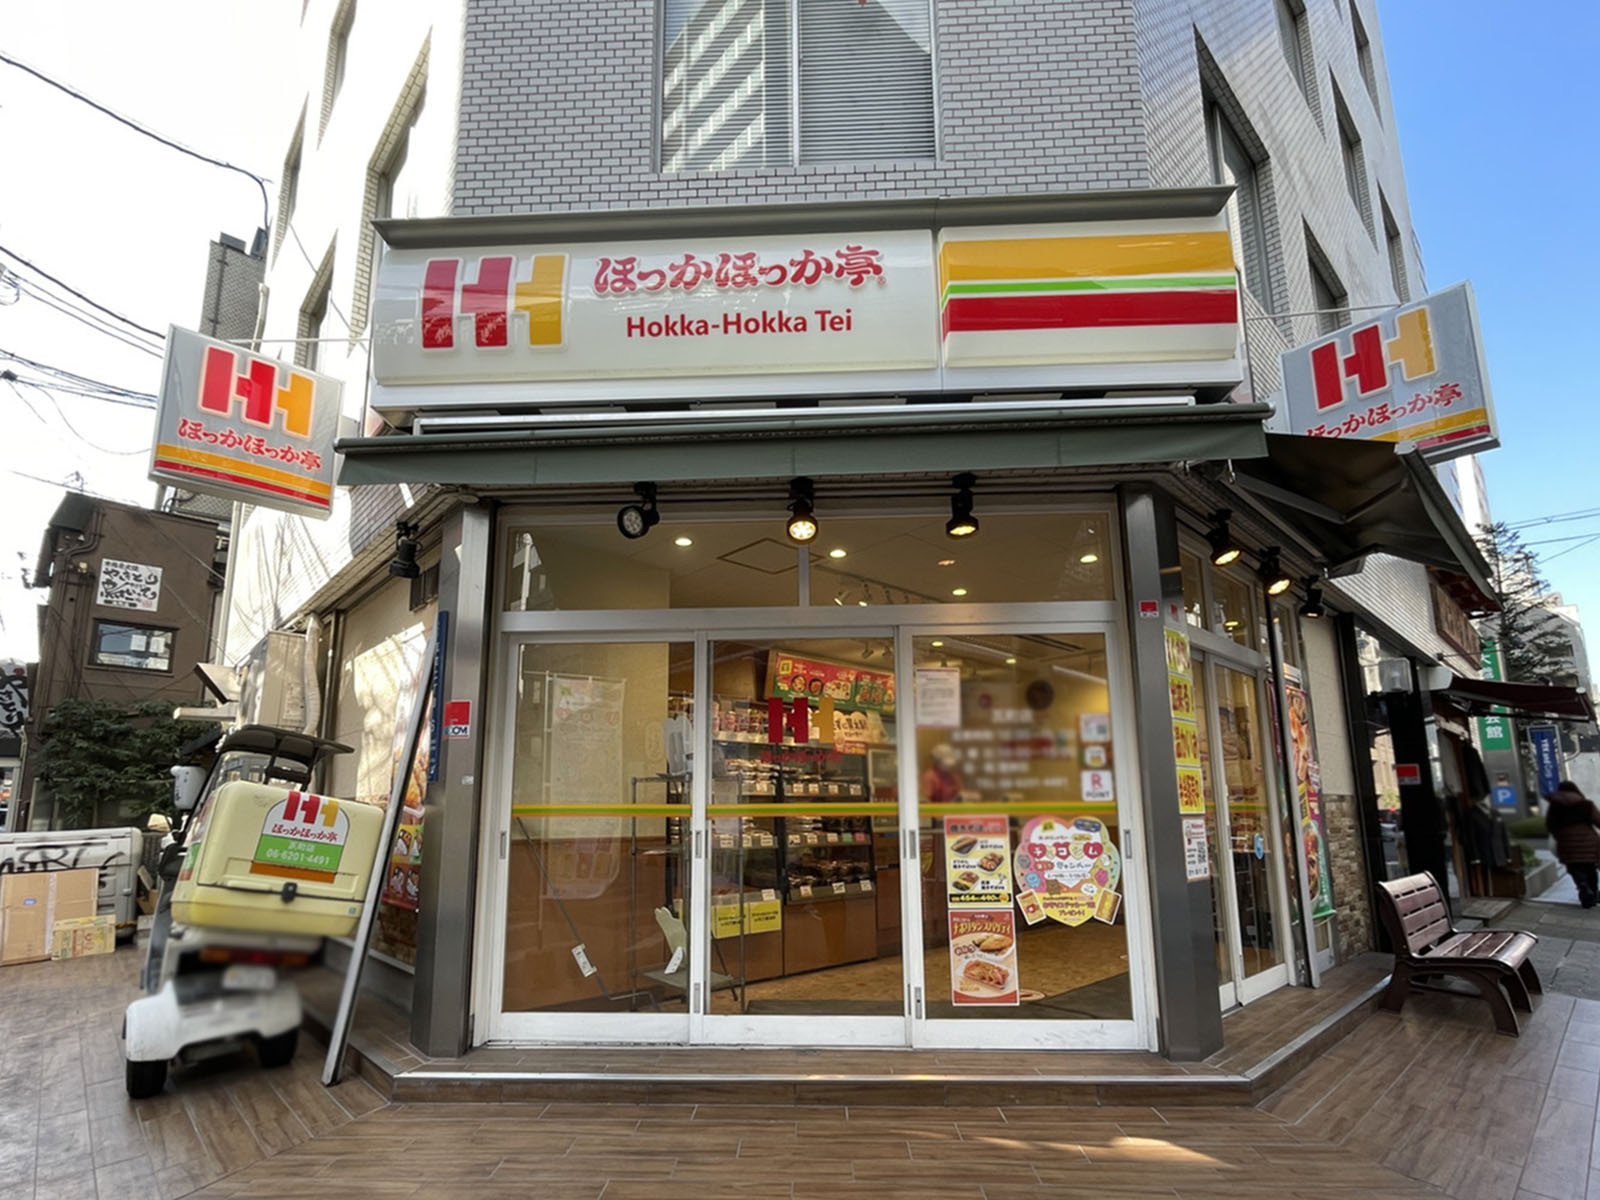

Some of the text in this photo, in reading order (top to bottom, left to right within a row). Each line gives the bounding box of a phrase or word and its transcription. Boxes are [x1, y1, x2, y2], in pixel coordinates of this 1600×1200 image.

[594, 245, 884, 293] ほっかほっか亭
[627, 308, 852, 337] Hokka-Hokka Tei
[178, 418, 321, 470] ほっかほっか亭
